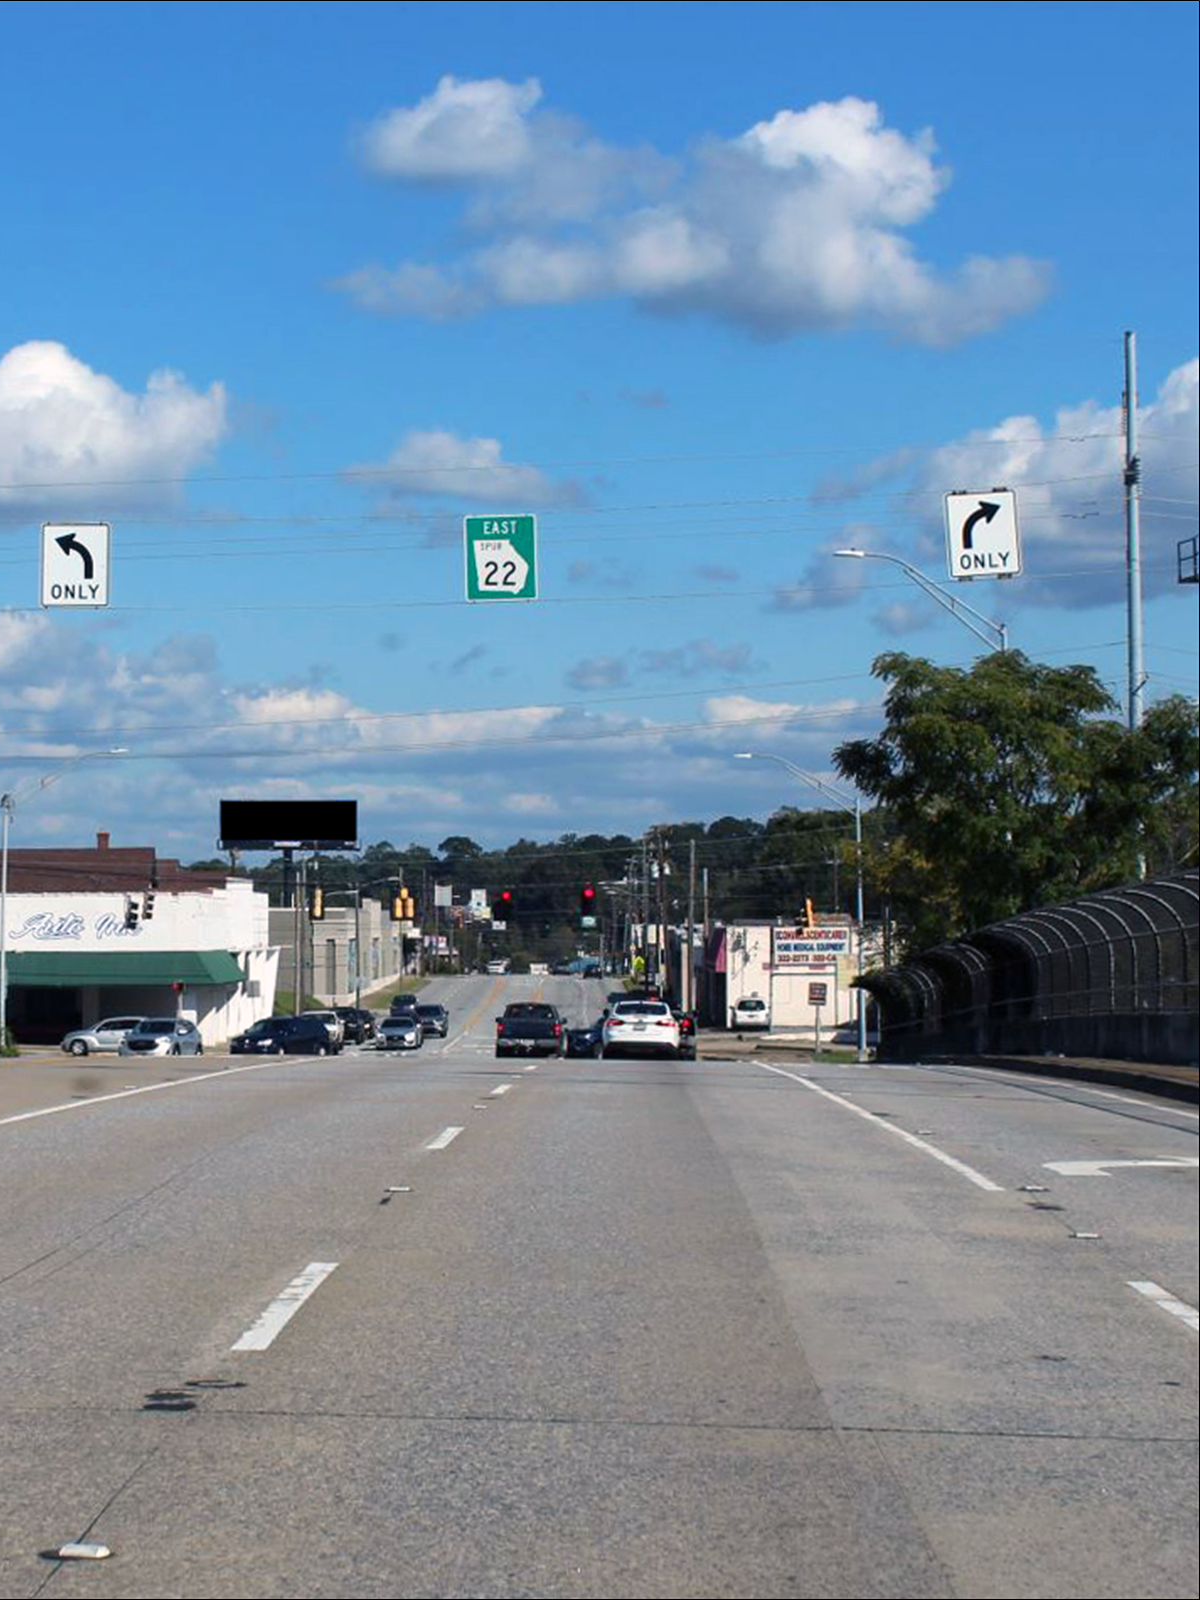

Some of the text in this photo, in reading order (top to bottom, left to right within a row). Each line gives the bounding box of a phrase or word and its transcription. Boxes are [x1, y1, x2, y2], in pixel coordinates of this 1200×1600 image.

[483, 520, 517, 535] EAST
[480, 542, 502, 551] SPUR
[959, 551, 1010, 570] ONLY
[484, 561, 517, 586] 22
[50, 584, 100, 600] ONLY
